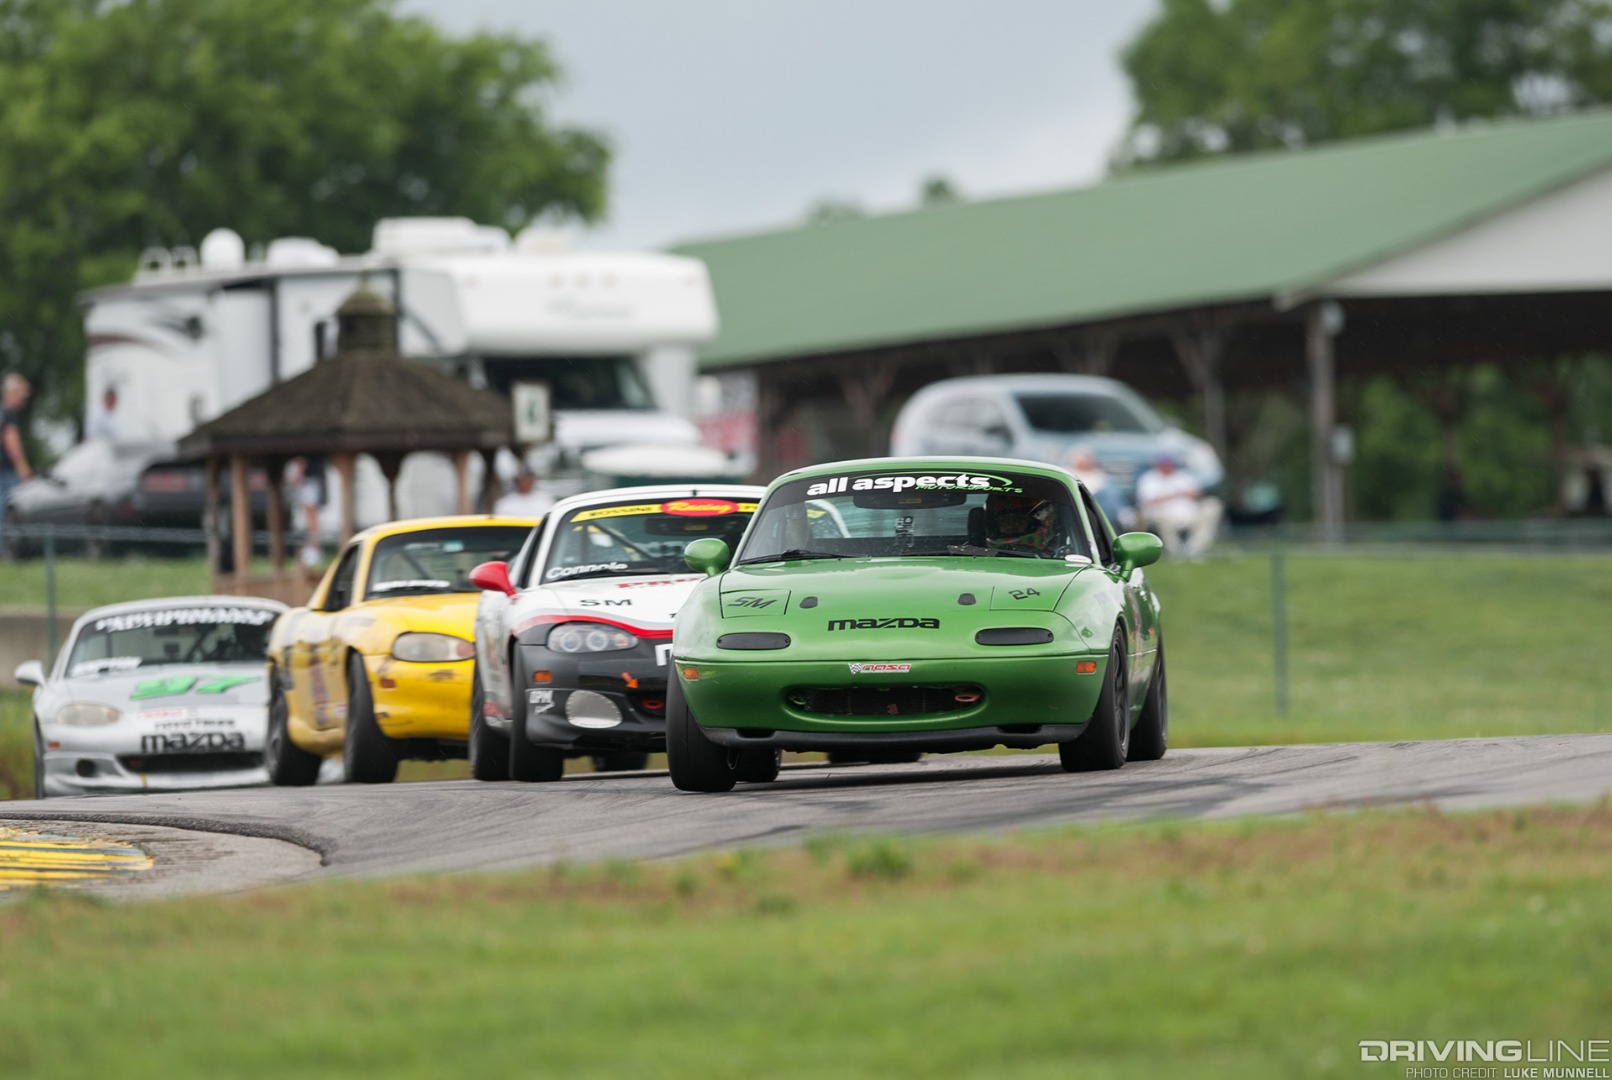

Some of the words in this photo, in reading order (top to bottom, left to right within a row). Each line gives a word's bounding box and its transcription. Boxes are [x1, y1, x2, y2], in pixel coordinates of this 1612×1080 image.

[807, 477, 848, 496] all
[852, 474, 990, 493] aspects
[667, 502, 731, 515] Racing
[1009, 587, 1041, 600] 24
[579, 598, 633, 607] SM
[727, 596, 778, 609] SM
